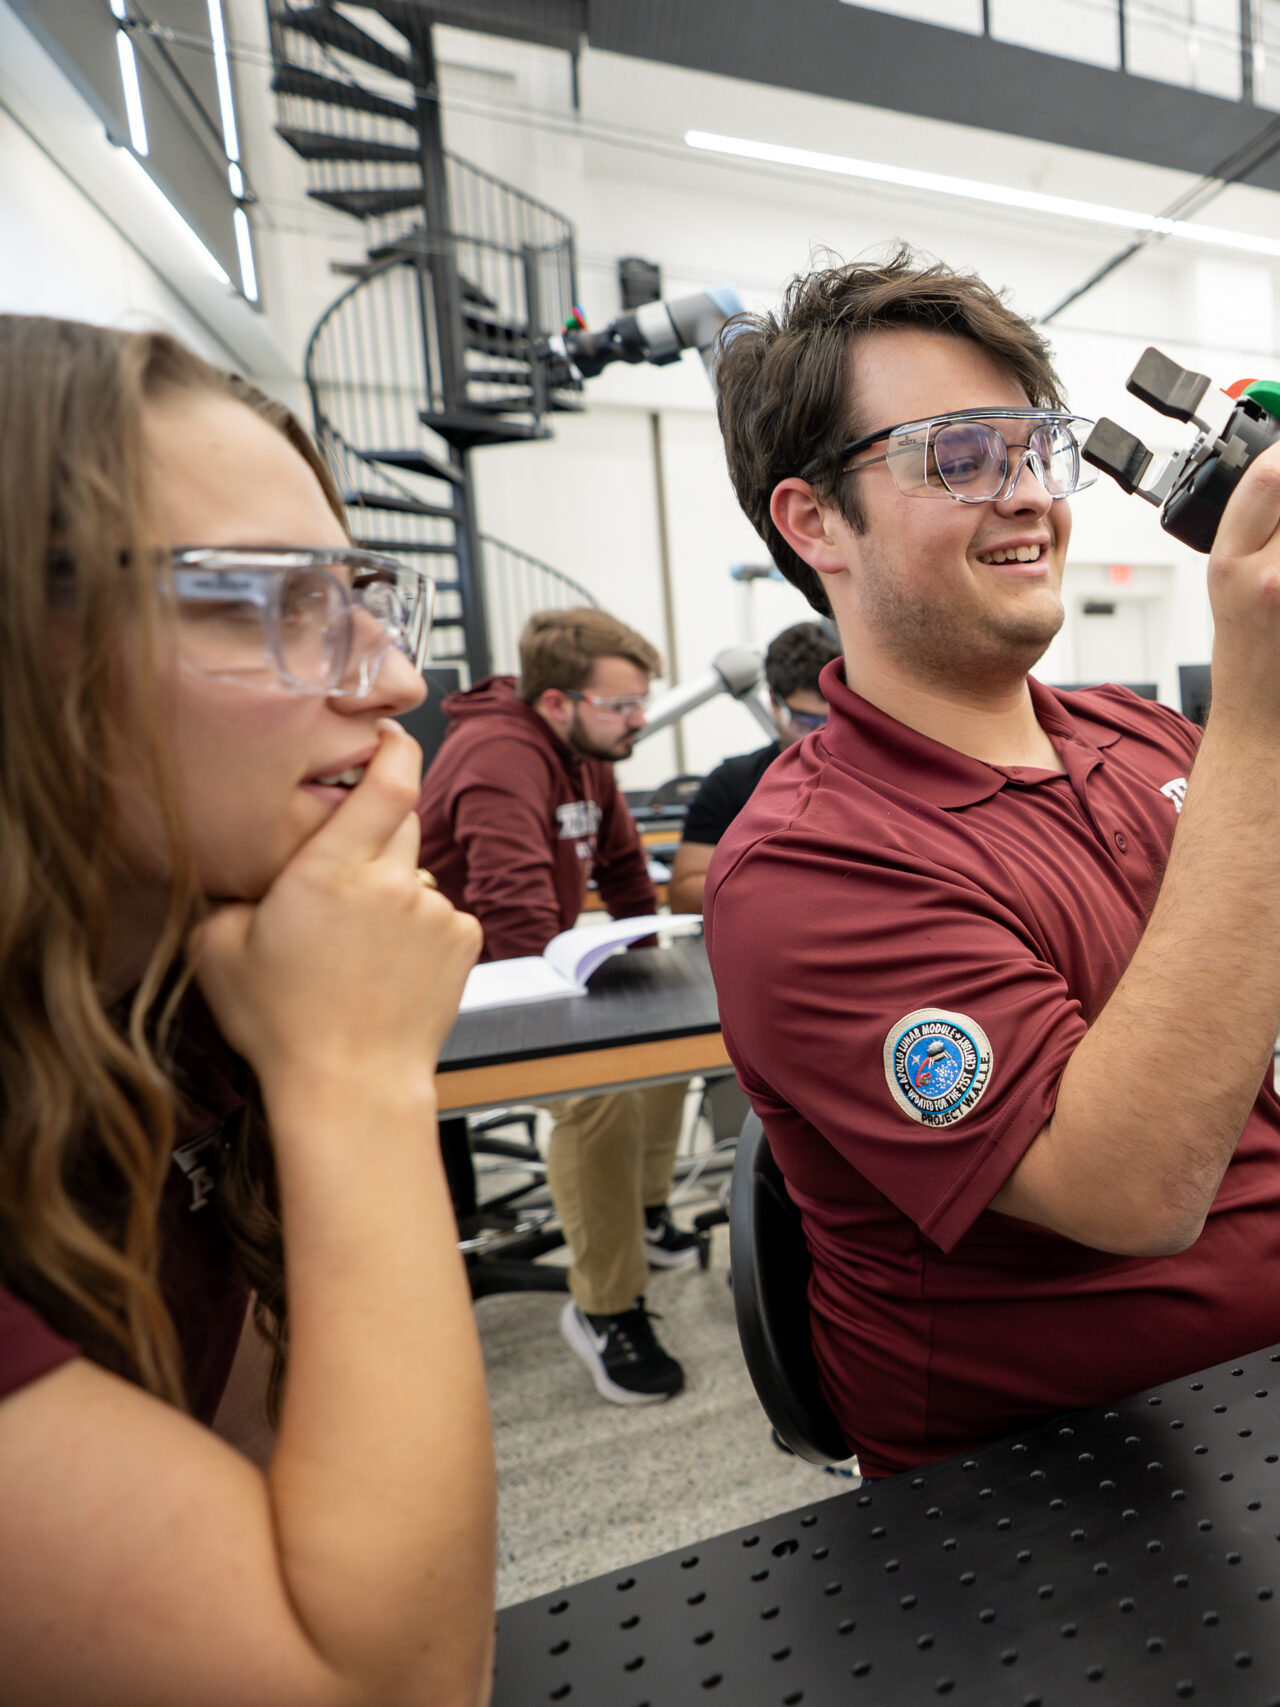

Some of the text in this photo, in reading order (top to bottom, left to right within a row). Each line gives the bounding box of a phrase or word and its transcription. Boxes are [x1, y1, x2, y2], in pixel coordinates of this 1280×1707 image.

[896, 1023, 957, 1084] APOLLO LUNAR MODULE
[907, 1036, 977, 1111] UPDATED FOR THE 21ST CENTURY
[921, 1106, 963, 1126] PROJECT
